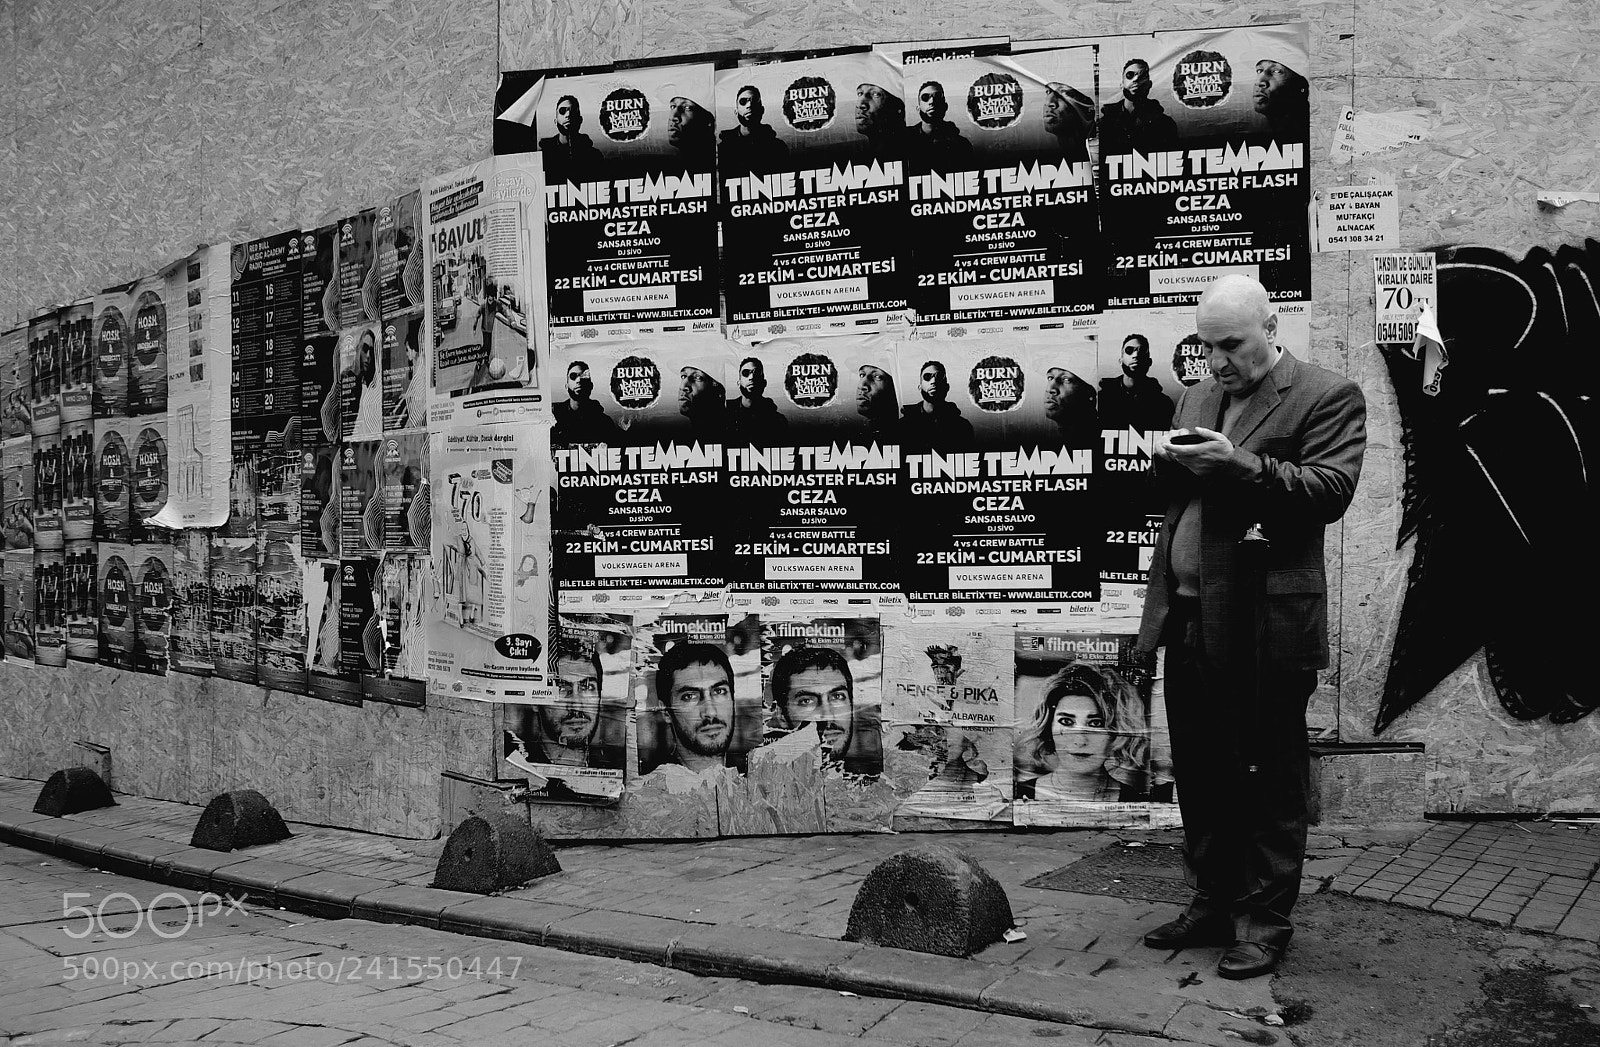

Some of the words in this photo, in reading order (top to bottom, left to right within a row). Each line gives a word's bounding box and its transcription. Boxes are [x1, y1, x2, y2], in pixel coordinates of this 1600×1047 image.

[1180, 60, 1225, 76] BURN
[789, 86, 828, 102] BURN
[1105, 148, 1184, 180] TINIE
[1188, 140, 1303, 175] TEMPAH
[725, 171, 796, 202] TINIE
[799, 158, 903, 193] TEMPAH
[909, 169, 980, 200] TINIE
[984, 157, 1093, 194] TEMPAH
[1111, 177, 1238, 196] GRANDMASTER
[1243, 173, 1297, 188] FLASH
[544, 179, 610, 209] TINIE
[614, 170, 711, 203] TEMPAH
[731, 195, 846, 217] GRANDMASTER
[850, 190, 898, 205] FLASH
[911, 194, 1032, 216] GRANDMASTER
[1036, 190, 1087, 206] FLASH
[1176, 194, 1231, 211] CEZA
[549, 205, 657, 223] GRANDMASTER
[661, 201, 706, 215] FLASH
[1167, 215, 1207, 224] SANSAR
[1210, 213, 1242, 222] SALVO
[790, 212, 840, 229] CEZA
[973, 212, 1025, 230] CEZA
[604, 220, 651, 236] CEZA
[439, 218, 483, 254] BAVUL
[784, 232, 819, 242] SANSAR
[821, 229, 850, 238] SALVO
[1116, 256, 1134, 268] 22
[1138, 252, 1178, 267] EKİM
[1192, 245, 1290, 264] CUMARTESİ
[1399, 257, 1406, 271] DE
[233, 291, 239, 302] 11
[266, 284, 273, 295] 16
[777, 289, 831, 299] VOLKSWAGEN
[958, 292, 1014, 300] VOLKSWAGEN
[1383, 287, 1413, 309] 70
[233, 318, 239, 328] 12
[266, 311, 273, 322] 17
[1378, 322, 1397, 342] 0544
[1398, 322, 1413, 341] 509
[232, 345, 239, 355] 13
[266, 339, 273, 350] 18
[232, 372, 239, 382] 14
[266, 367, 273, 378] 19
[792, 364, 831, 377] BURN
[976, 367, 1018, 381] BURN
[232, 398, 239, 408] 15
[265, 394, 273, 405] 20
[625, 440, 722, 472] TEMPAH
[727, 443, 795, 474] TINIE
[799, 440, 900, 473] TEMPAH
[906, 449, 980, 480] TINIE
[984, 445, 1092, 478] TEMPAH
[560, 473, 668, 487] GRANDMASTER
[672, 472, 717, 484] FLASH
[730, 474, 844, 487] GRANDMASTER
[848, 473, 896, 485] FLASH
[911, 480, 1032, 494] GRANDMASTER
[1036, 478, 1087, 491] FLASH
[616, 489, 662, 503] CEZA
[788, 490, 836, 504] CEZA
[973, 496, 1024, 511] CEZA
[1106, 531, 1124, 543] 22
[917, 553, 934, 564] 22
[937, 550, 975, 563] EKİM
[988, 547, 1080, 563] CUMARTESİ
[1070, 605, 1094, 614] biletix
[662, 619, 726, 633] filmekimi
[778, 623, 845, 637] filmekimi
[1047, 637, 1119, 653] filmekimi
[964, 687, 998, 701] PIKA
[952, 712, 995, 722] ALBAYRAK
